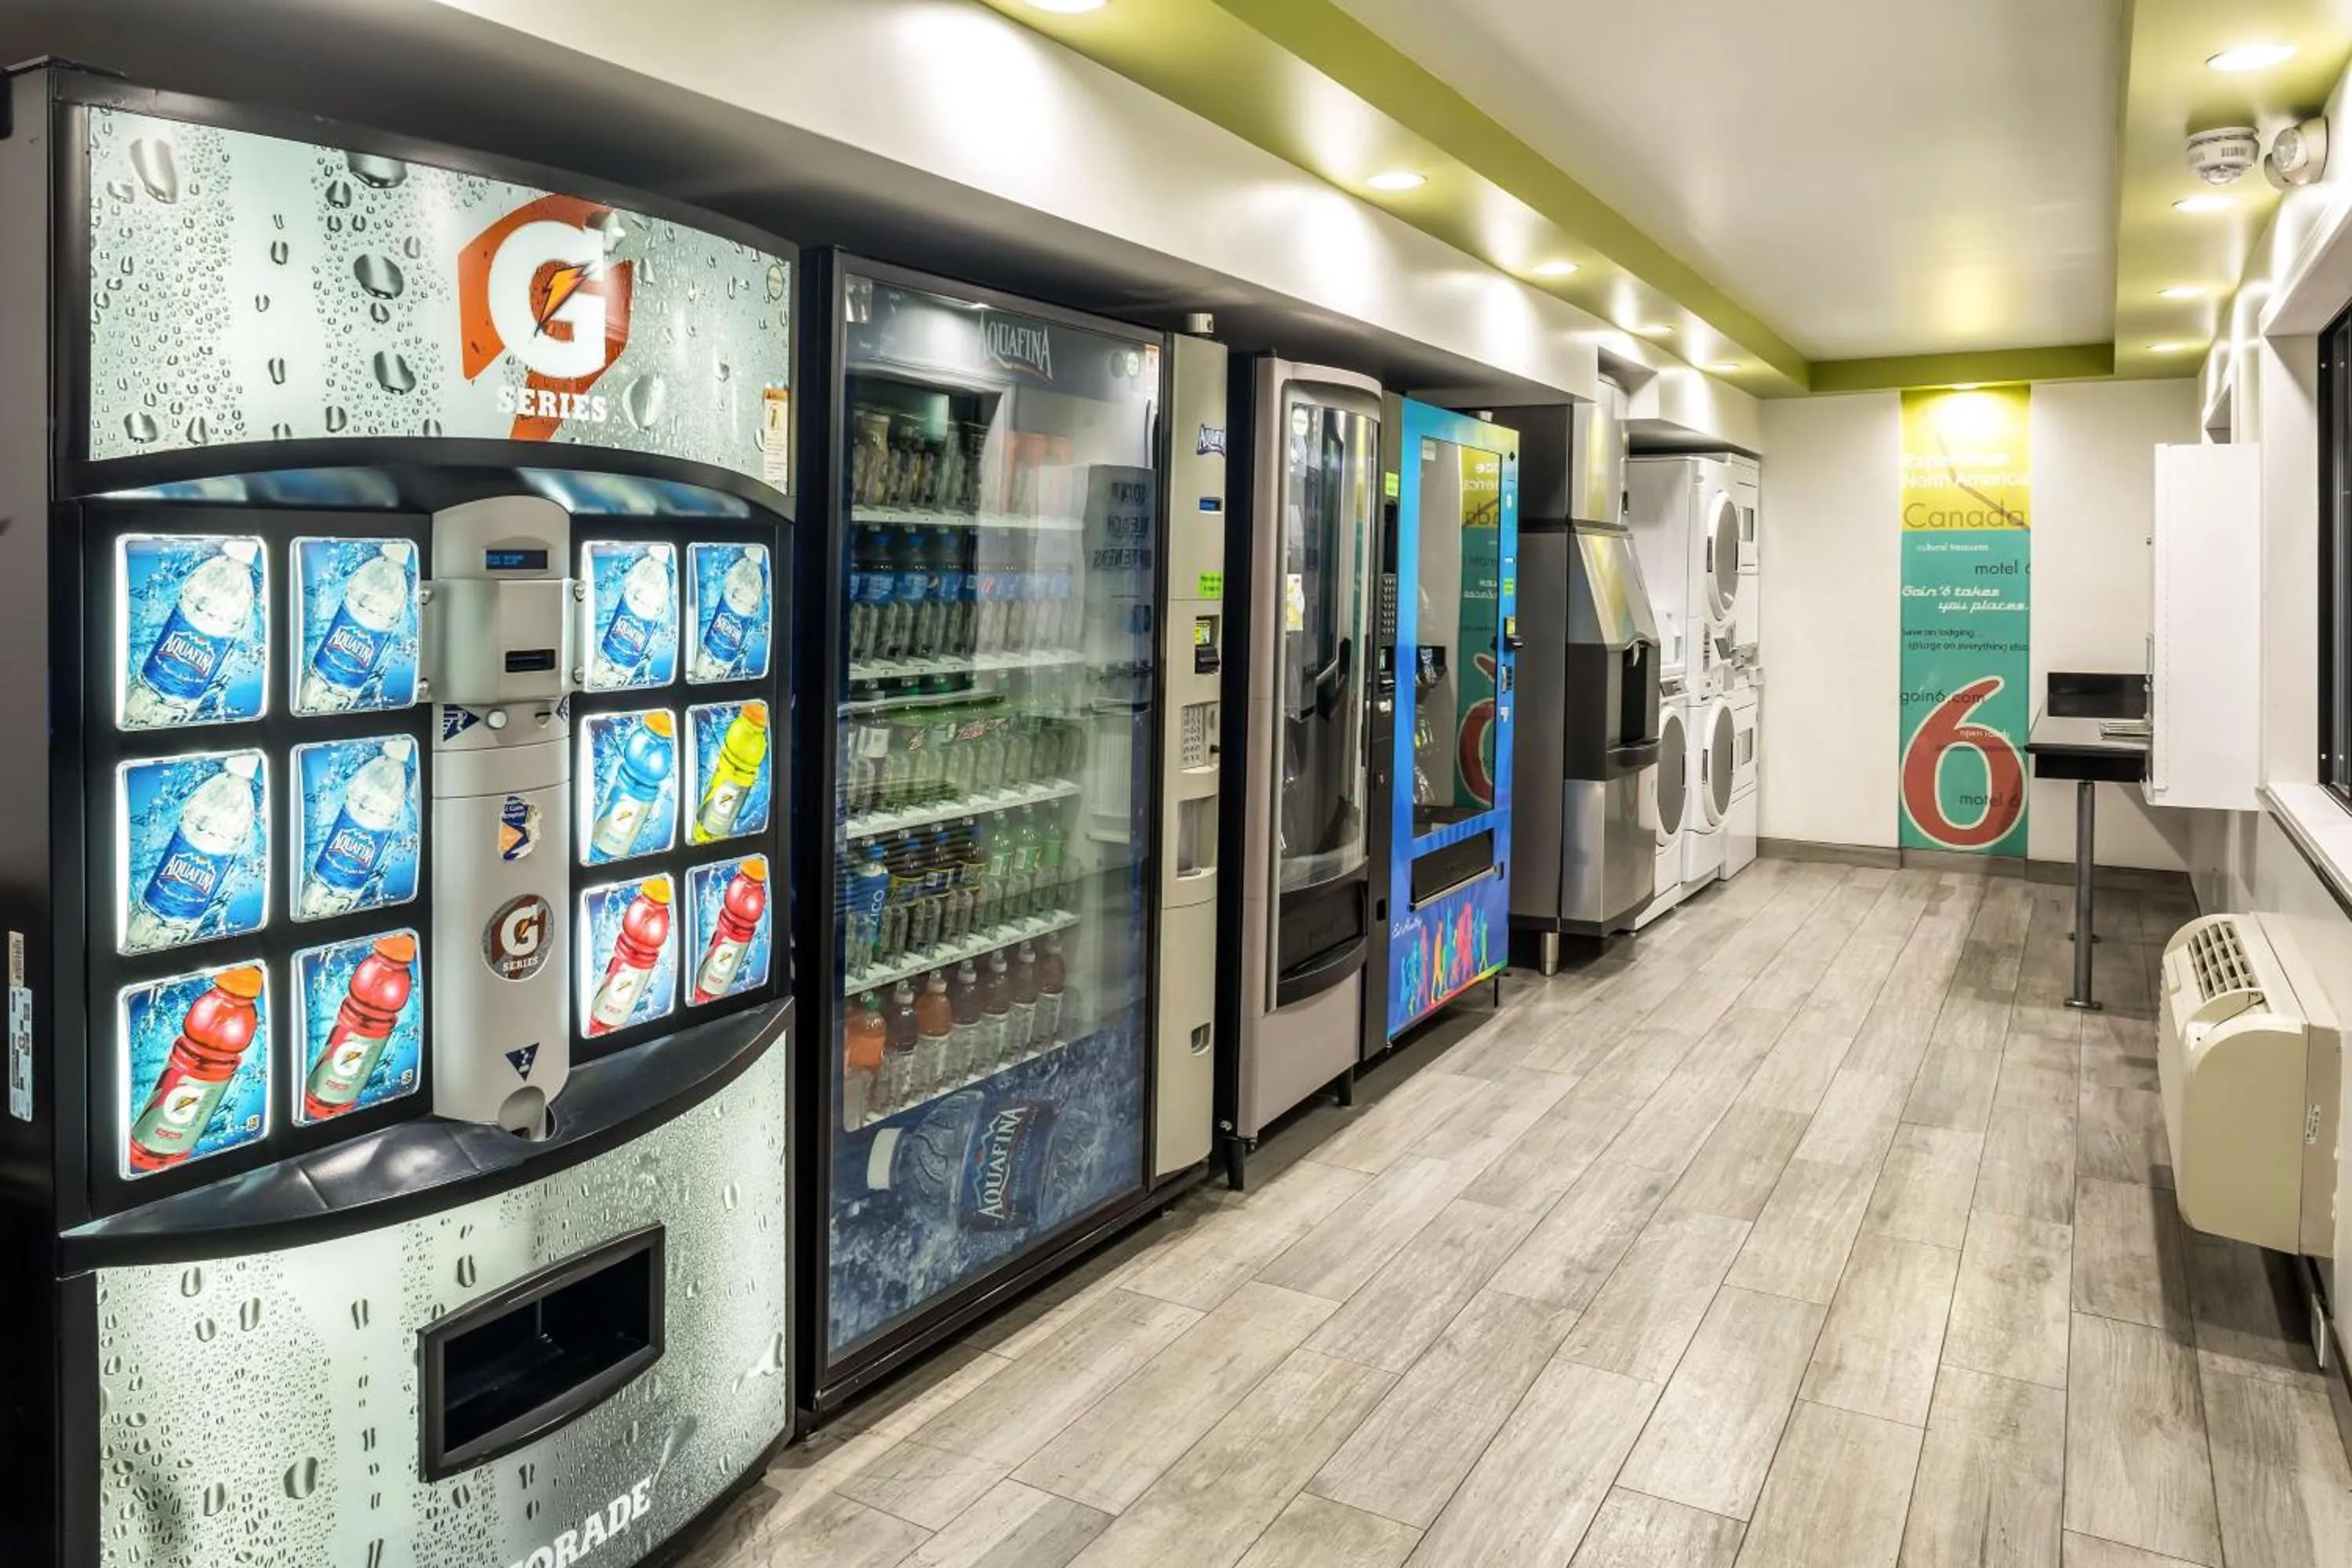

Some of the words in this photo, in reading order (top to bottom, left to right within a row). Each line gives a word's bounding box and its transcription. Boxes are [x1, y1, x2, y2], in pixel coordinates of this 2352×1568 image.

[488, 220, 607, 379] G
[978, 310, 1053, 380] AQUAFINA
[497, 384, 608, 423] SERIES
[1904, 497, 2026, 528] Canada
[1974, 559, 2019, 575] motel
[1938, 601, 1968, 614] you
[1954, 585, 2000, 597] takes
[1900, 689, 1986, 706] goin6.com
[1900, 675, 2028, 851] 6
[1959, 793, 2004, 807] motel
[500, 904, 539, 956] G
[503, 956, 539, 972] SERIES
[978, 1106, 1029, 1219] AQUAFINA
[510, 1474, 653, 1568] ORADE
